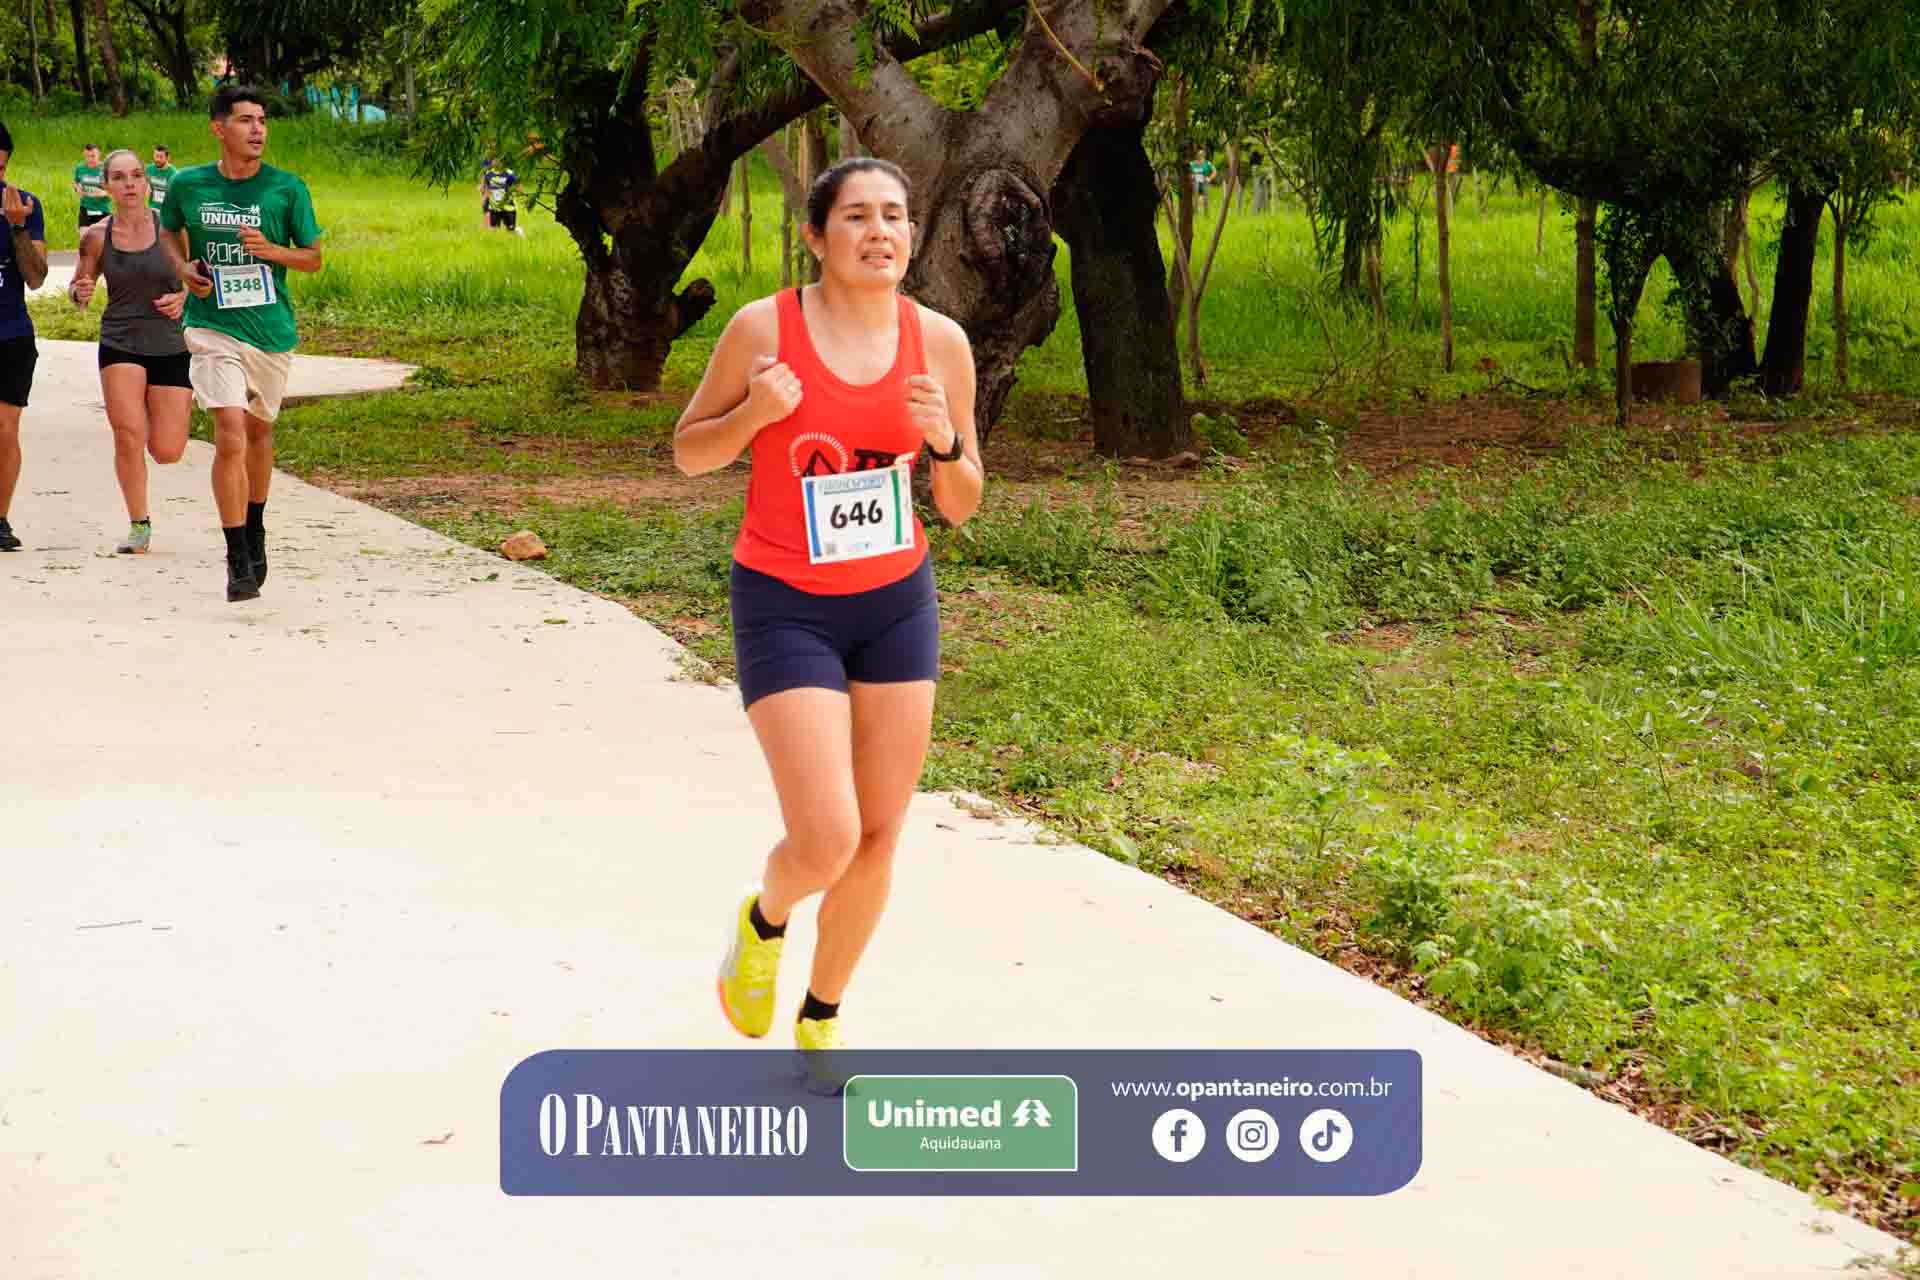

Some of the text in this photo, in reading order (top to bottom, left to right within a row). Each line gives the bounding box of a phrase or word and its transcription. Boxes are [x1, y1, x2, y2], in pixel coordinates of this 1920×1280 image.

[200, 212, 262, 227] UNIMED
[223, 277, 262, 294] 3348
[829, 498, 883, 529] 646
